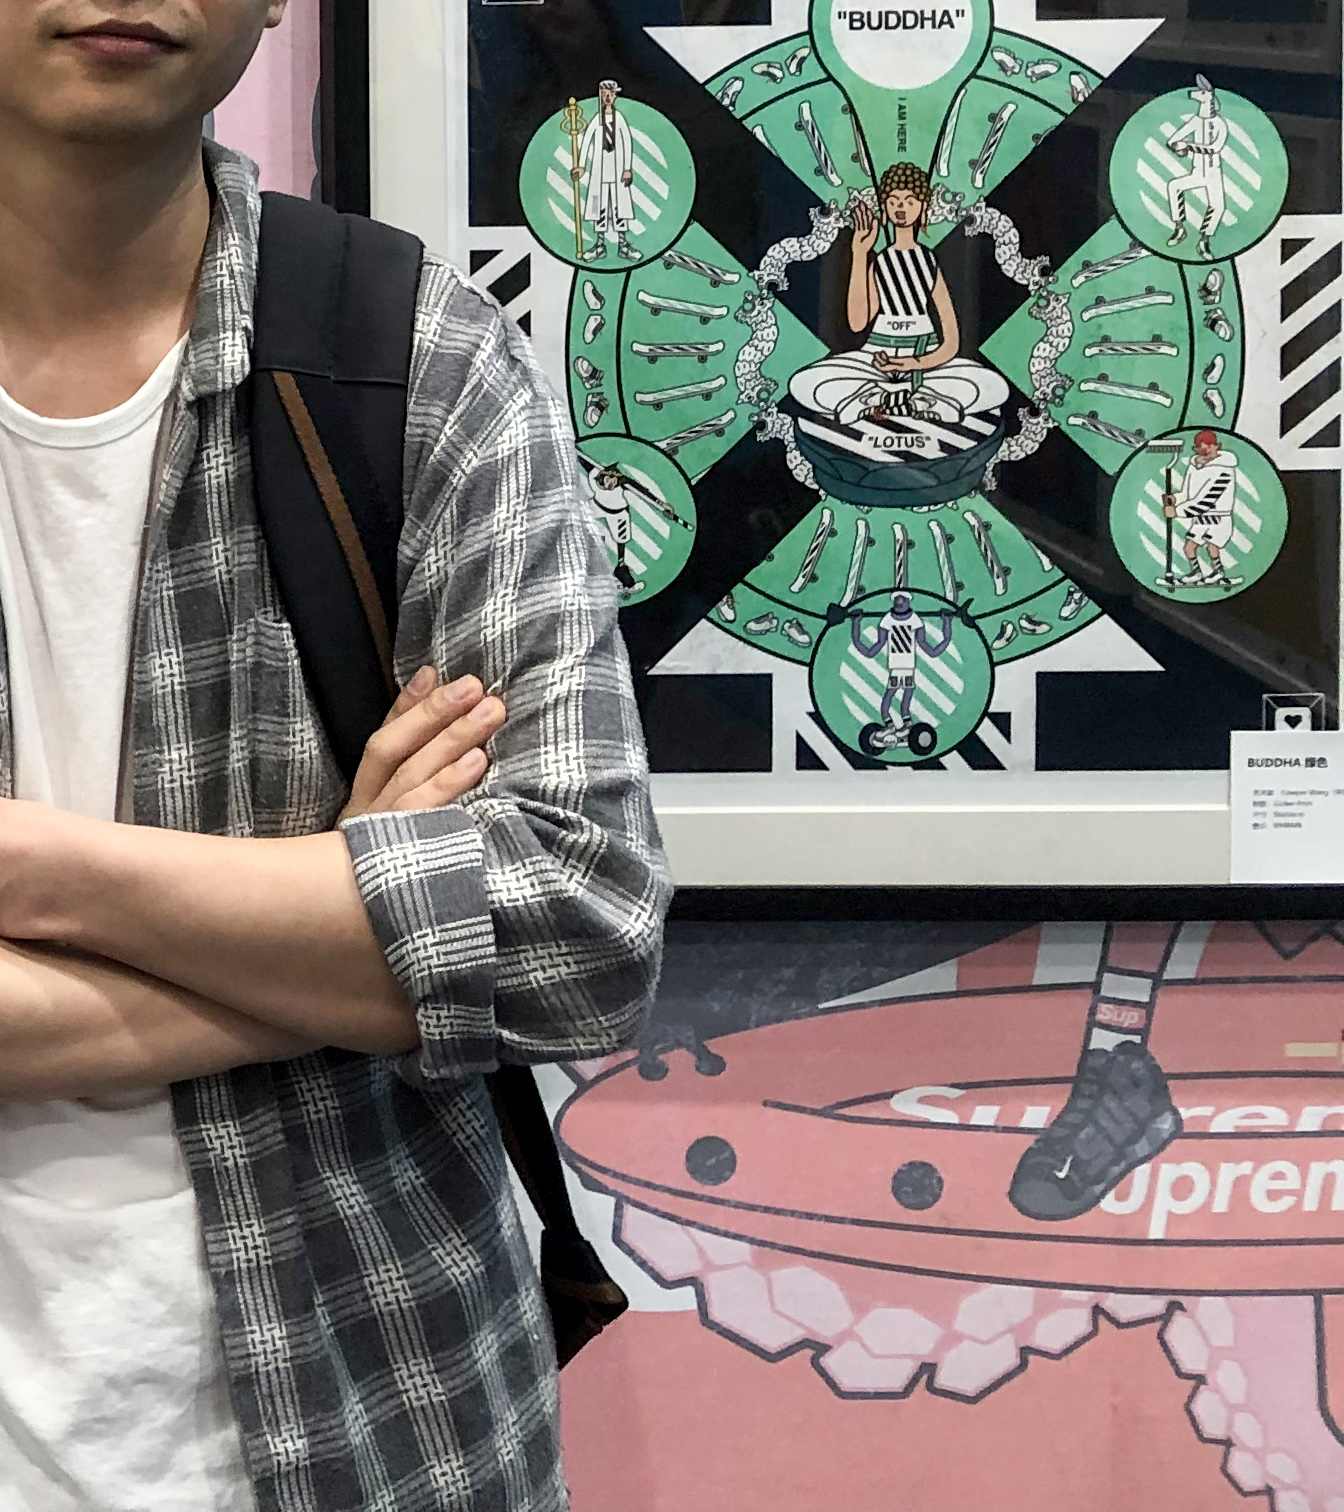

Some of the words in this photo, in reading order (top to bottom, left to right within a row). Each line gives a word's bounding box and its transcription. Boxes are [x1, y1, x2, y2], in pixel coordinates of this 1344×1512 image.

[838, 8, 965, 31] "BUDDHA"
[898, 103, 907, 121] AM
[897, 123, 907, 153] HERE
[1247, 757, 1302, 768] BUDDHA
[1097, 1003, 1139, 1028] Sup
